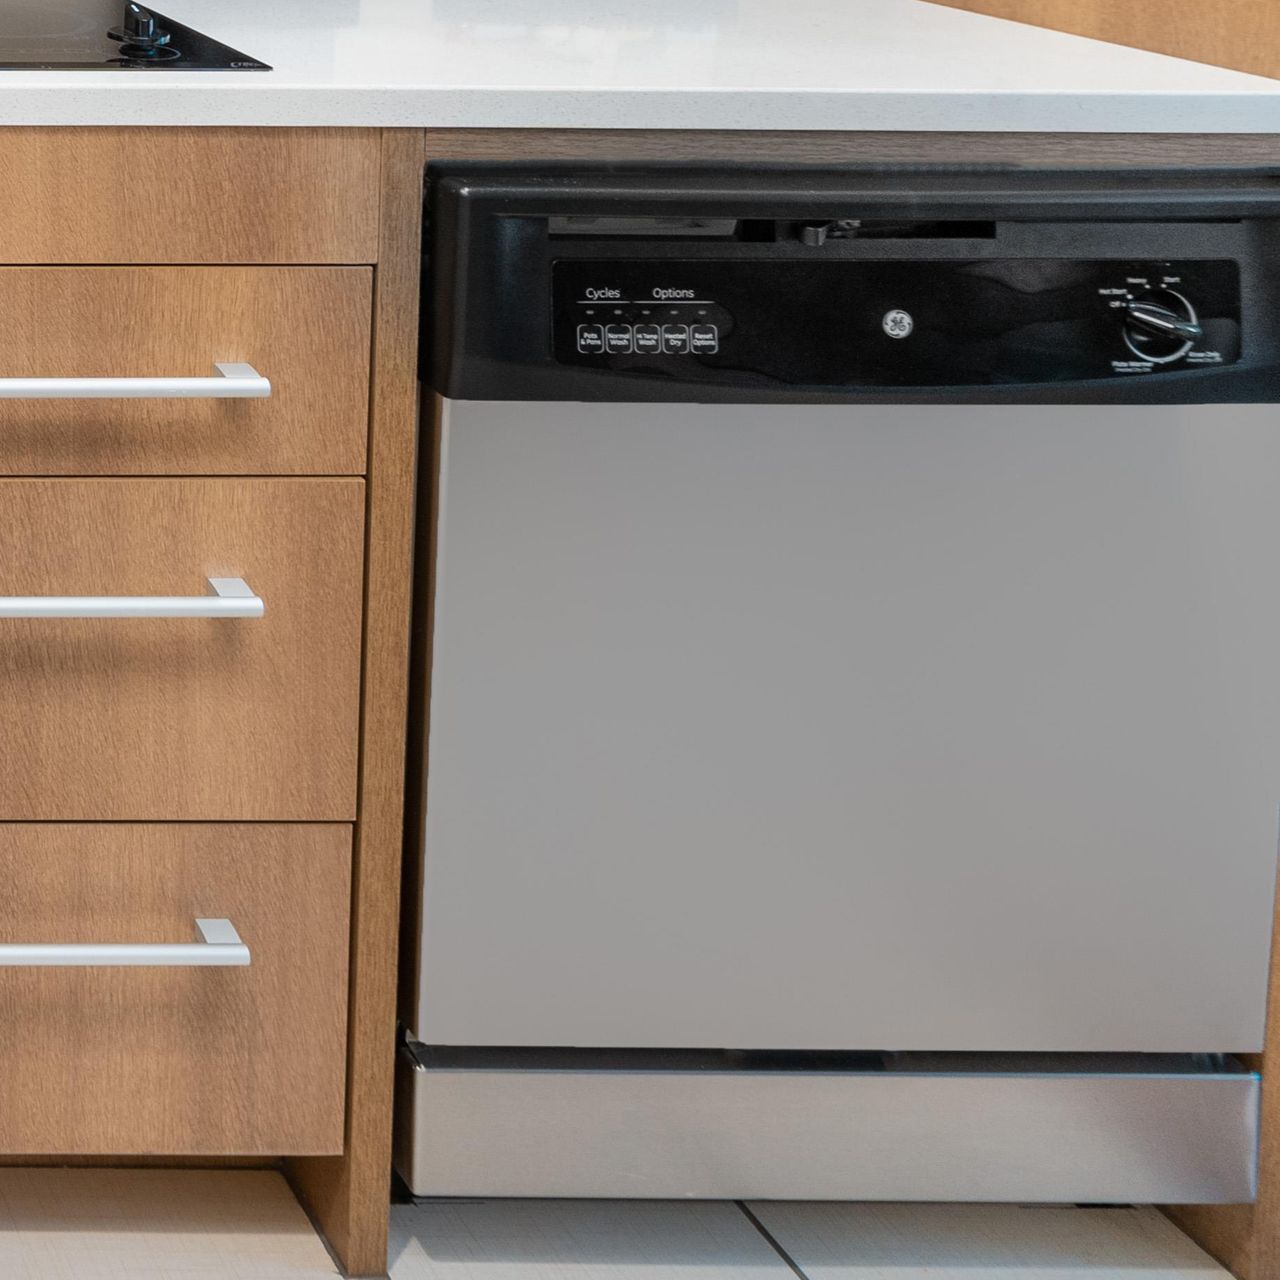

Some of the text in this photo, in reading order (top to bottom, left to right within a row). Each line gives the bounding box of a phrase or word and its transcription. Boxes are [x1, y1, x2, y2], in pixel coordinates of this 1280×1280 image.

[586, 288, 621, 300] Cycles
[653, 288, 695, 300] Options
[669, 339, 682, 347] Dry
